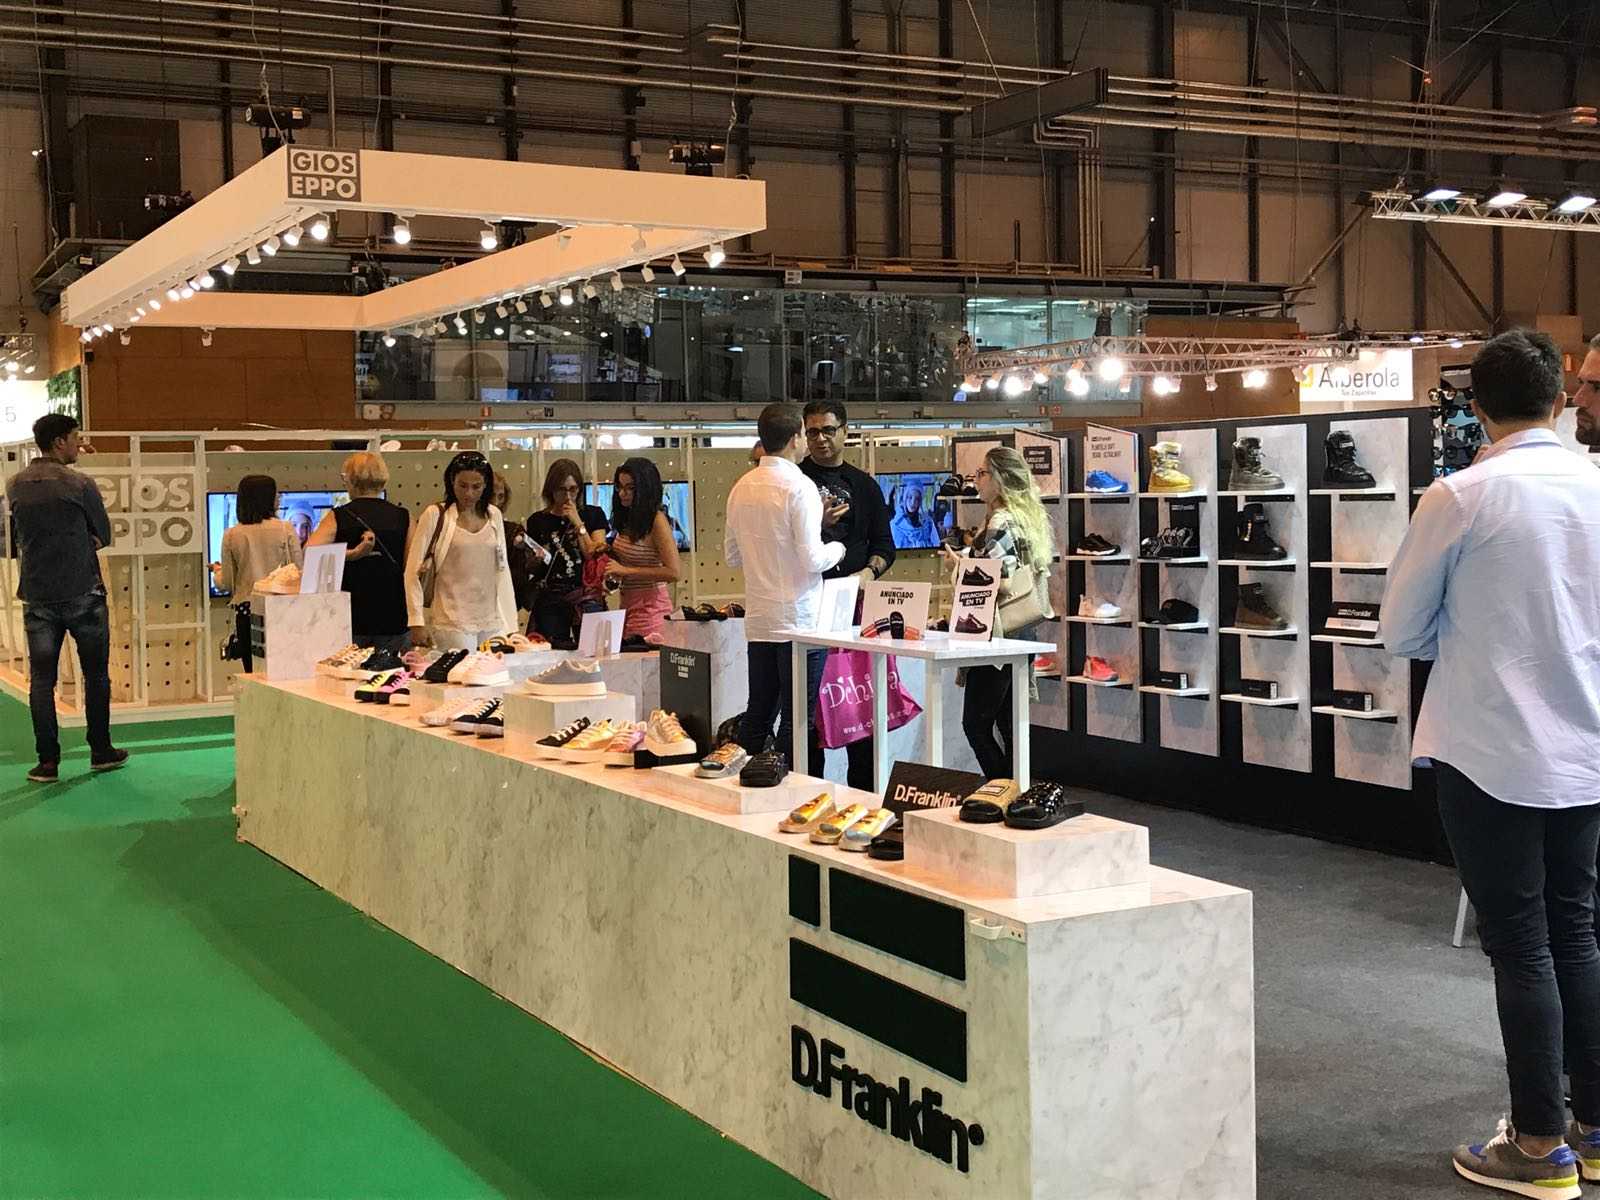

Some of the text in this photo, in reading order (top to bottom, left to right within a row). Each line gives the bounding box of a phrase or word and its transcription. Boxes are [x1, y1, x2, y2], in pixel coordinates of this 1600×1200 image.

[293, 152, 354, 174] GIOS
[292, 176, 356, 199] EPPO
[110, 517, 193, 547] PPO
[880, 590, 914, 599] ANUNCIADO
[961, 591, 991, 599] ANUNCIADO
